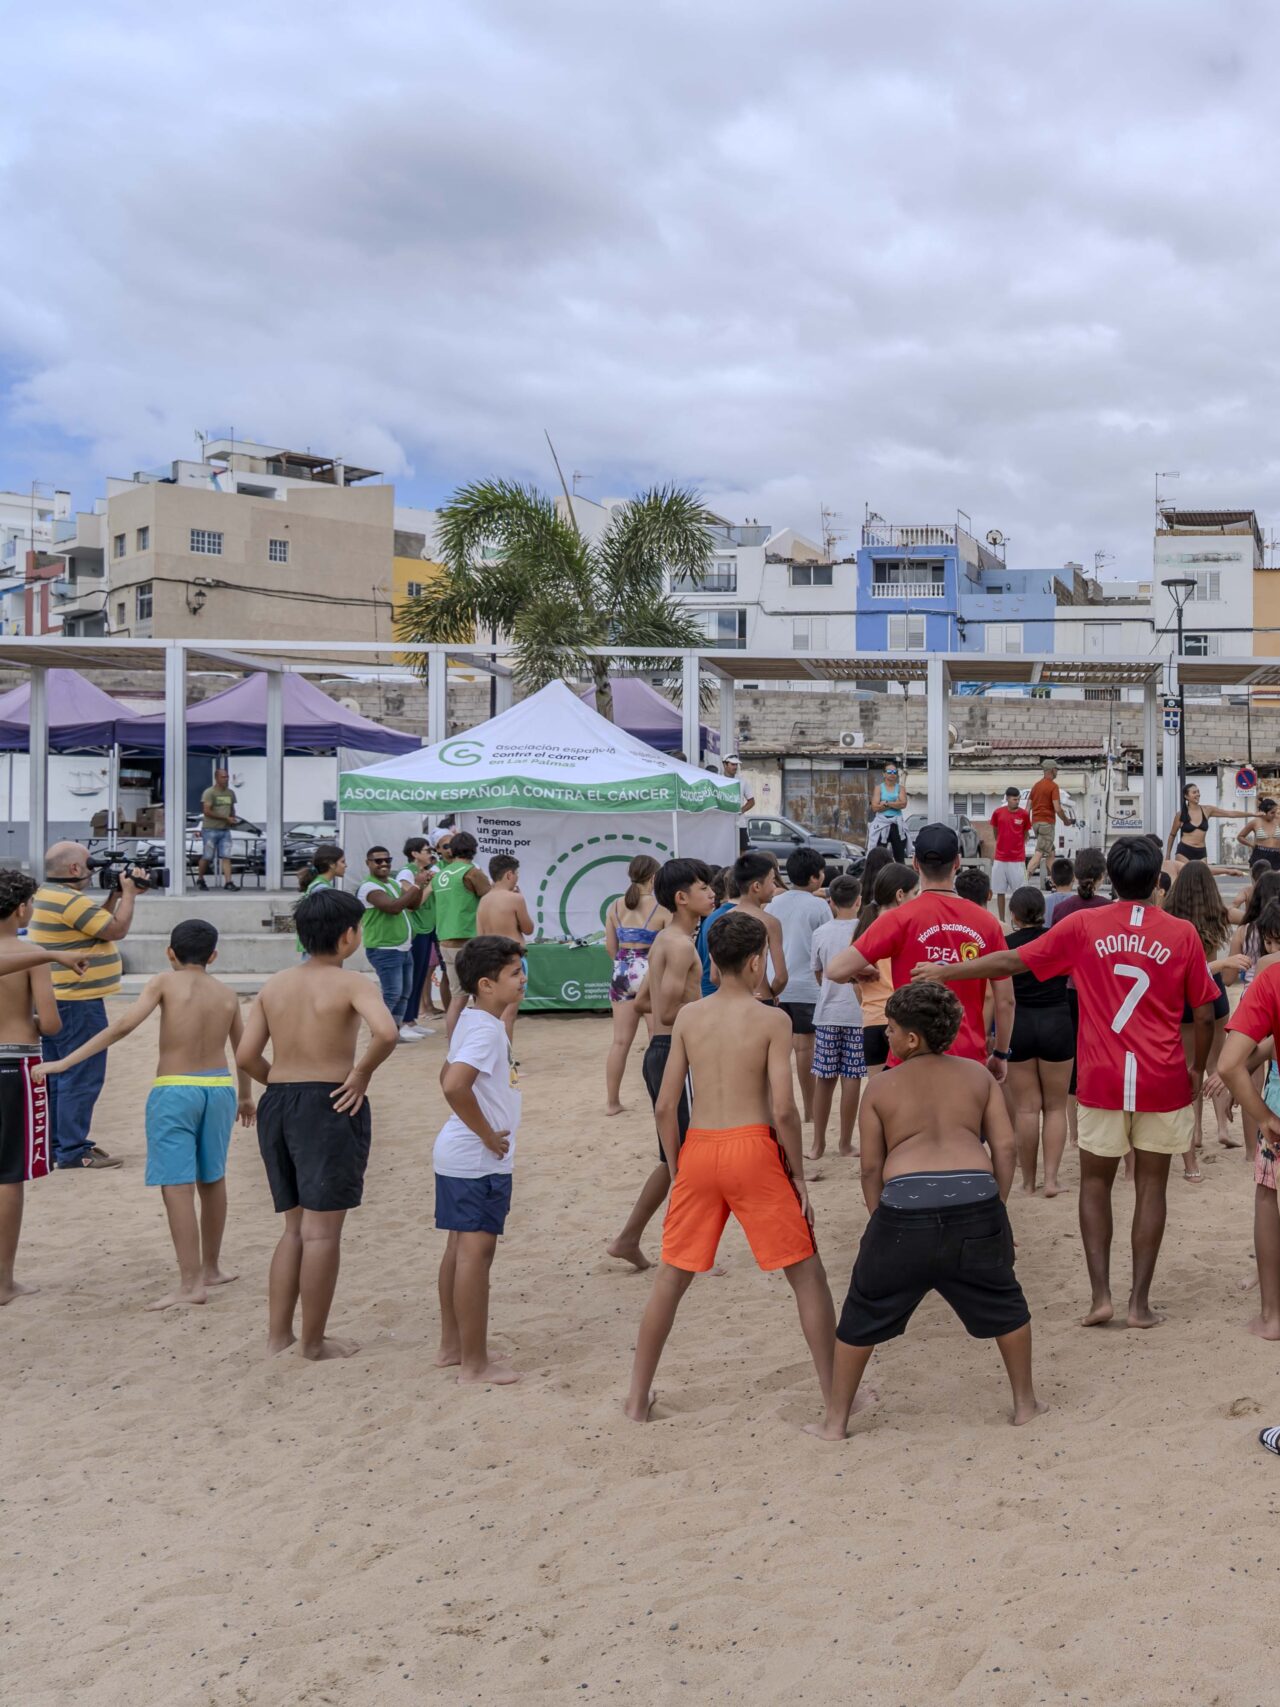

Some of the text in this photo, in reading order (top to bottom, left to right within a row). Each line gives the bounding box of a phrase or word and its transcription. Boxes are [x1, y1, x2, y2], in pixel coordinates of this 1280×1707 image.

[495, 743, 560, 751] asociación
[531, 759, 576, 768] Palmas
[344, 786, 437, 801] ASOCIACIÓN
[440, 784, 519, 800] ESPAÑOLA
[523, 785, 583, 801] CONTRA
[587, 790, 605, 801] EL
[607, 787, 670, 801] CÁNCER
[476, 816, 521, 826] Tenemos
[491, 829, 514, 837] gran
[479, 837, 531, 848] camino por
[479, 845, 515, 855] delante
[1094, 933, 1172, 965] RONALDO
[1111, 963, 1150, 1034] 7
